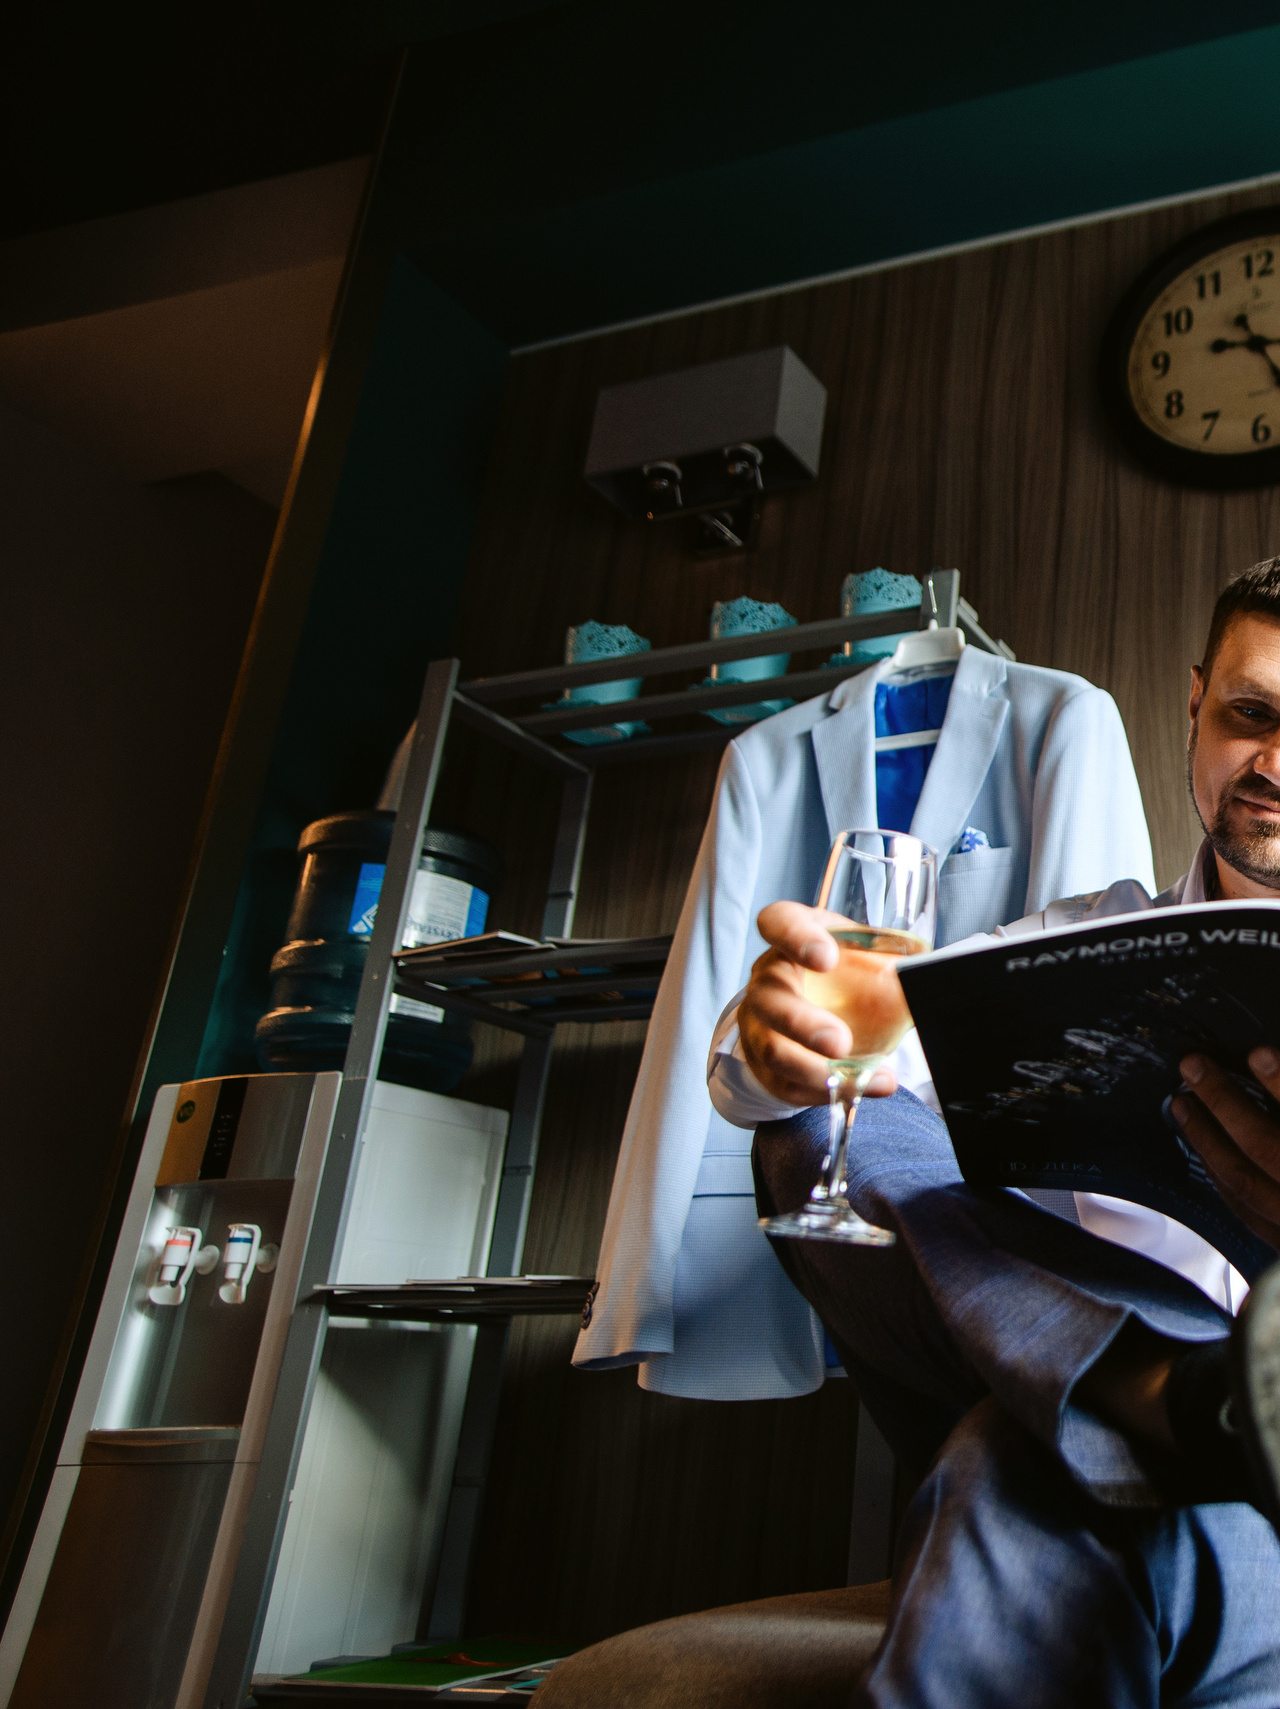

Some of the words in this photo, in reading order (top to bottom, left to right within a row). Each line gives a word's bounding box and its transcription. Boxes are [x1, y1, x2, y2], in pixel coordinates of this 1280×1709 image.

[1241, 250, 1275, 279] 12
[1196, 271, 1221, 299] 11
[1163, 306, 1194, 337] 10
[1152, 351, 1171, 379] 9
[1164, 389, 1185, 419] 8
[1202, 409, 1221, 441] 7
[1252, 413, 1271, 443] 6
[1005, 931, 1190, 973] RAYMOND
